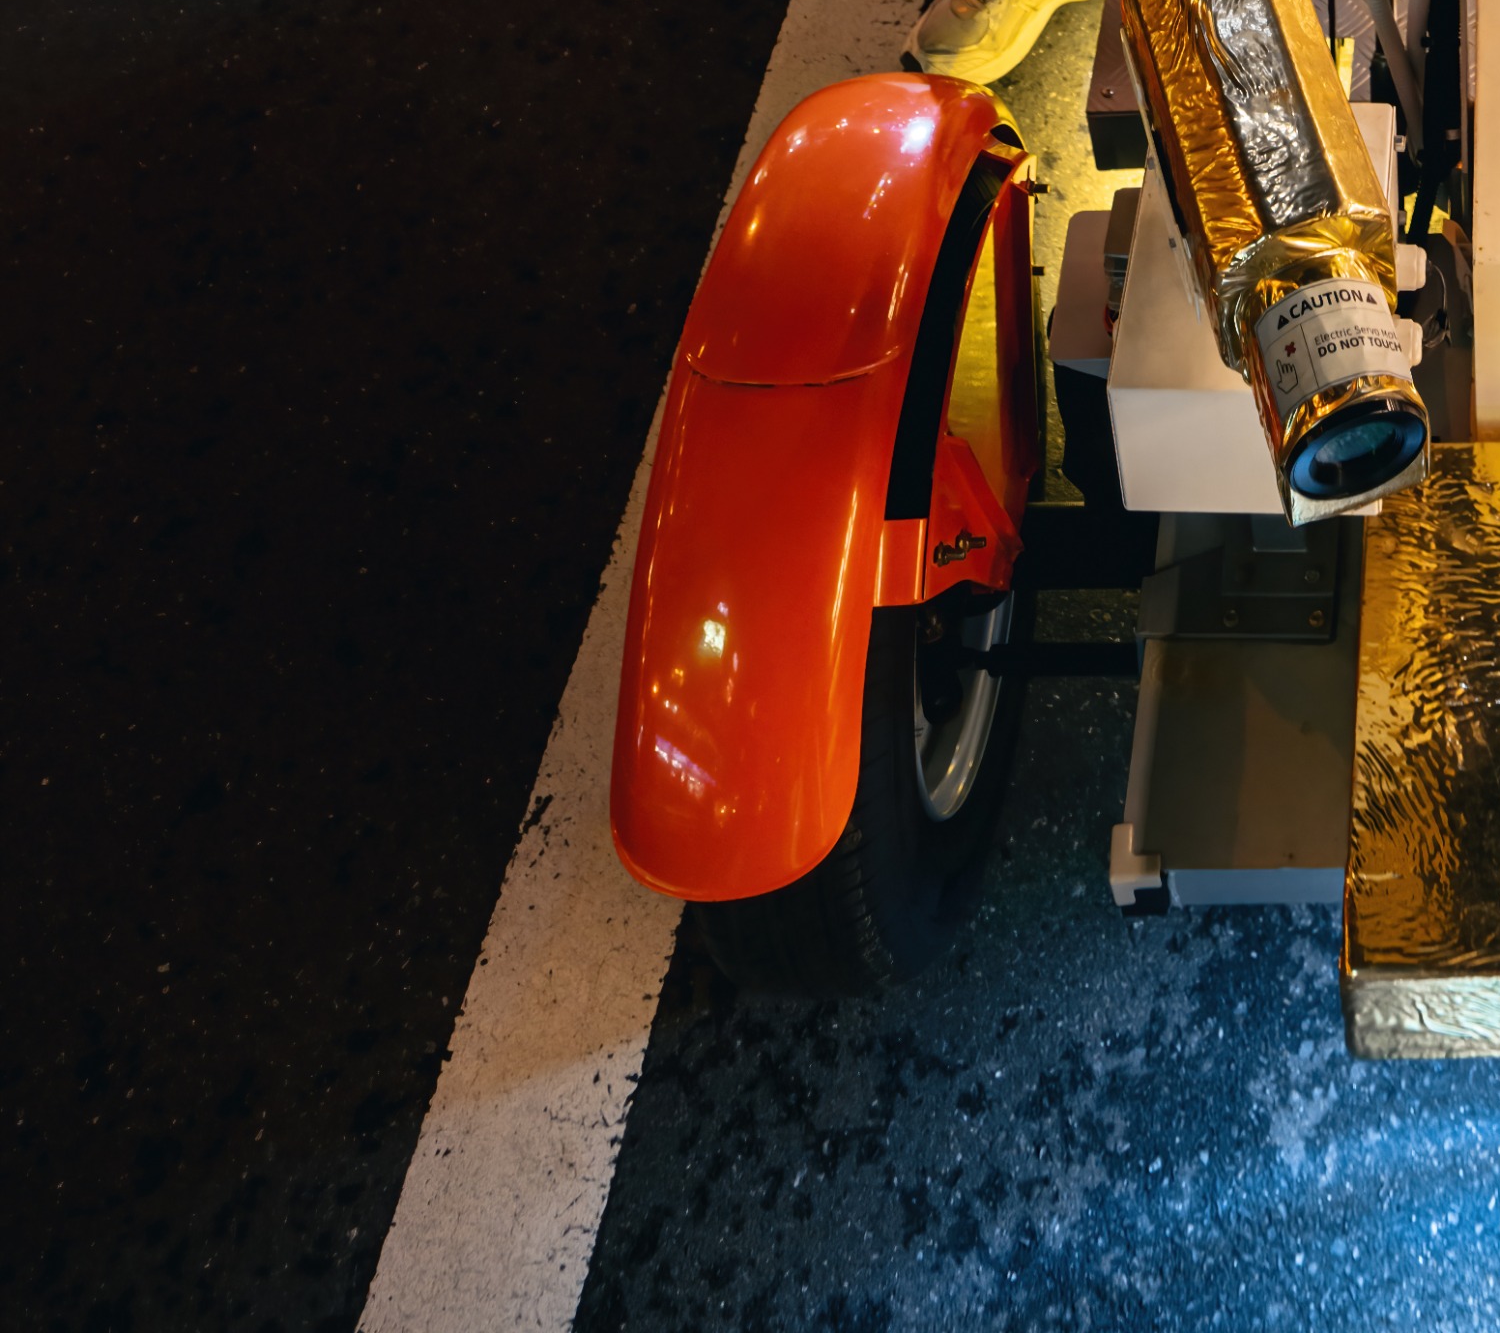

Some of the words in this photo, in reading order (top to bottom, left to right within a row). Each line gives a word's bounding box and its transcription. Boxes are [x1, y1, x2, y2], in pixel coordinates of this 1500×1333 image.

[1289, 288, 1364, 319] CAUTION
[1314, 327, 1353, 346] Electric
[1354, 325, 1380, 337] Servo
[1317, 342, 1338, 358] DO
[1339, 336, 1366, 351] NOT
[1368, 336, 1403, 352] TOUCH
